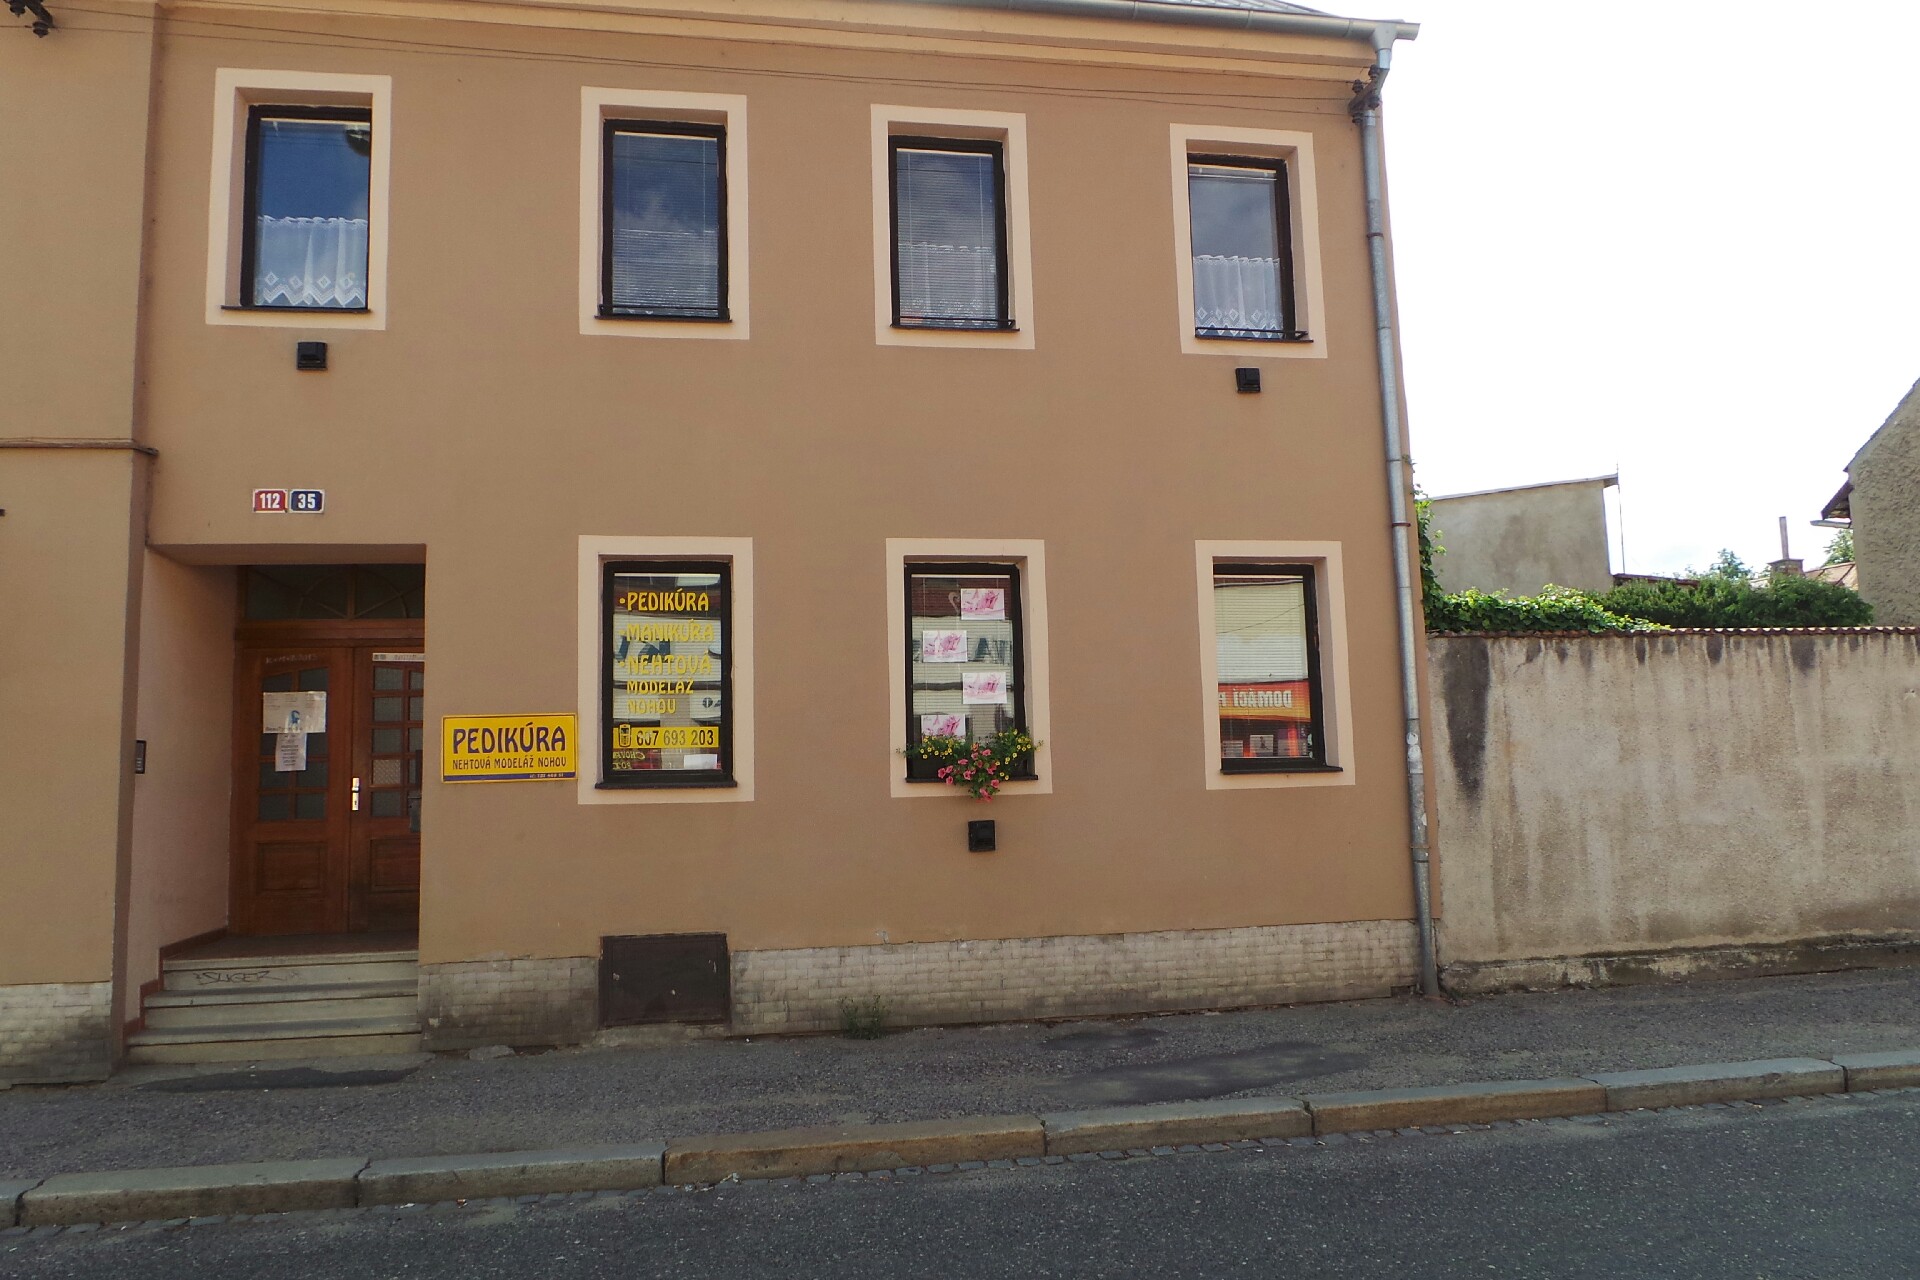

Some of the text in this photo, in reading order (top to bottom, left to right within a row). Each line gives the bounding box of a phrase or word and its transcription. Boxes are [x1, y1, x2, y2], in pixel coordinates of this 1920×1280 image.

[259, 493, 281, 509] 112
[297, 493, 316, 509] 35
[626, 588, 710, 612] PEDIKÚRA
[626, 619, 715, 642] MANIKÚRA
[627, 648, 713, 675] NEHTOVÁ
[626, 677, 695, 695] MODELÁŽ
[627, 699, 677, 715] NOHOU
[452, 721, 566, 754] PEDIKÚRA
[663, 730, 686, 746] 693
[690, 730, 714, 747] 203
[452, 756, 491, 770] NEHTOVÁ
[494, 755, 534, 769] MODELÁŽ
